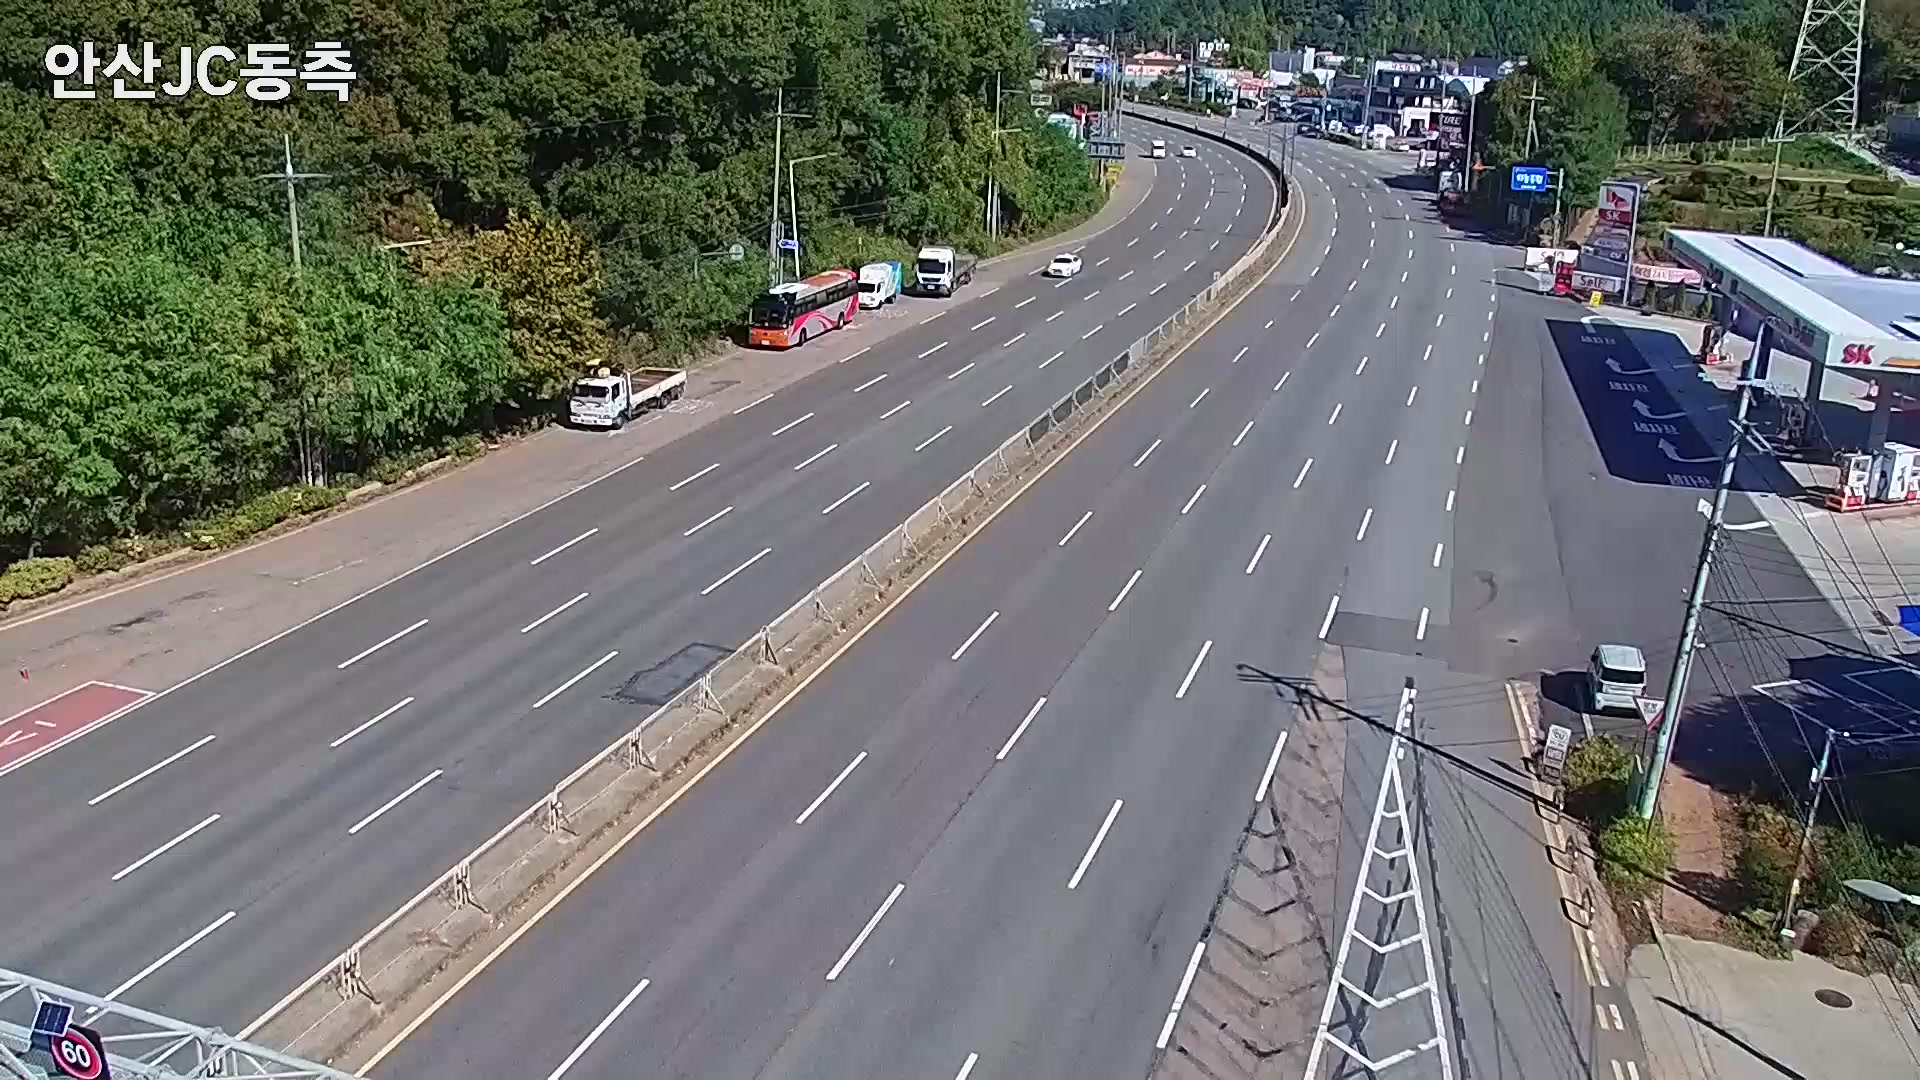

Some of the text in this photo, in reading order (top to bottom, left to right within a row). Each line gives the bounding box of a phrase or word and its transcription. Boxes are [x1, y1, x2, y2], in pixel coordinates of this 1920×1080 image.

[1605, 210, 1621, 221] SK
[1842, 344, 1875, 364] SK
[61, 1040, 91, 1068] 60
